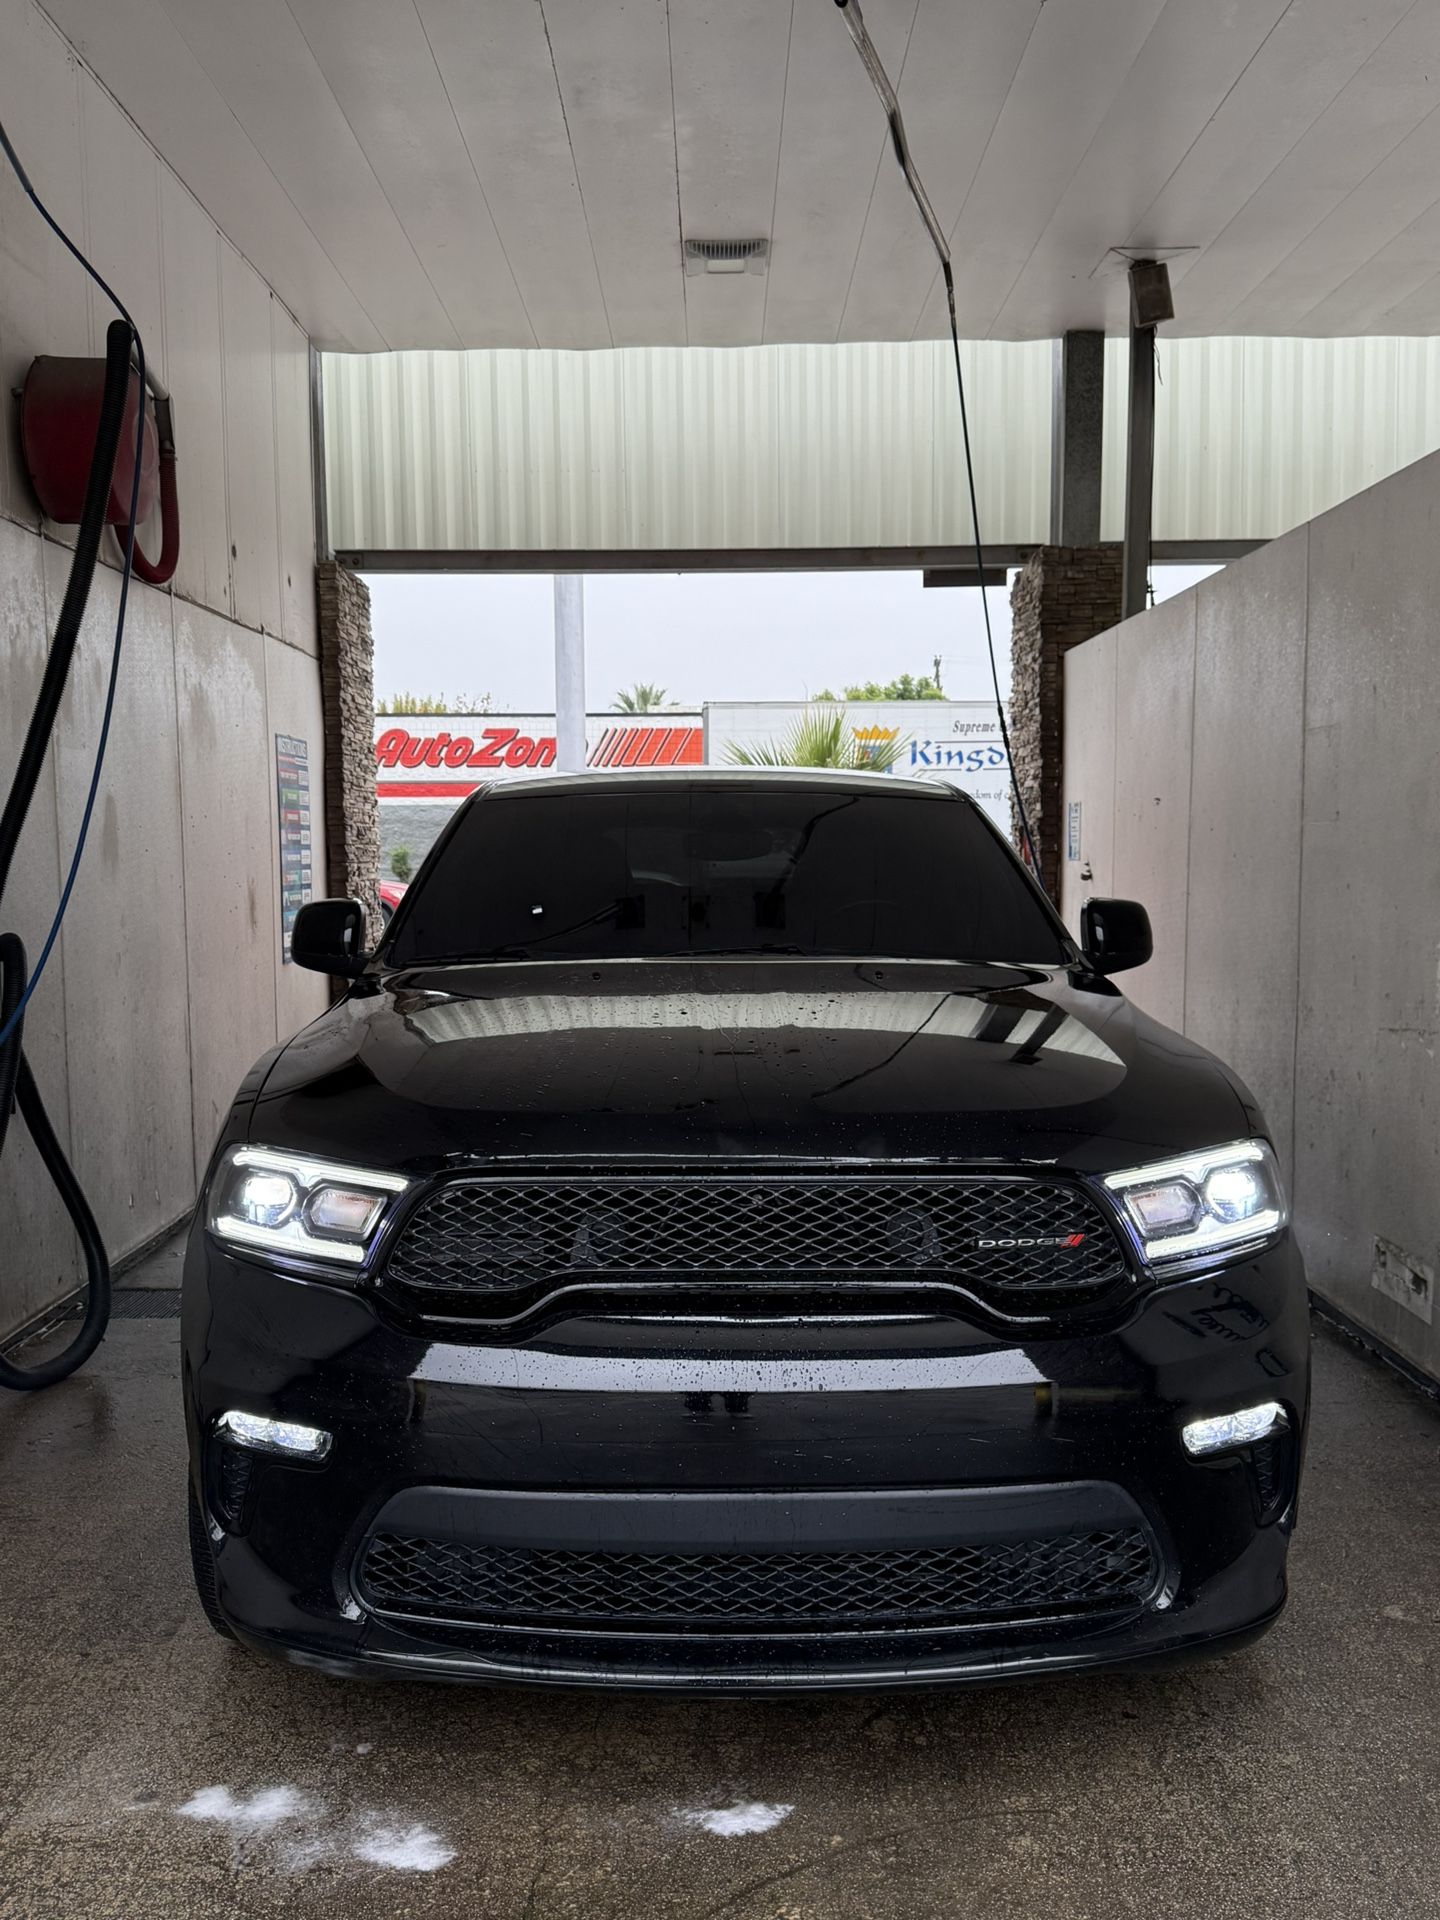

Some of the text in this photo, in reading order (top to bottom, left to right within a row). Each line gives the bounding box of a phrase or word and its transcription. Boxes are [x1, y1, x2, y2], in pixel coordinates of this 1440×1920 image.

[953, 720, 995, 736] Supreme
[374, 727, 588, 768] AutoZon
[909, 740, 1007, 772] Kingd
[978, 1238, 1070, 1247] DODGE
